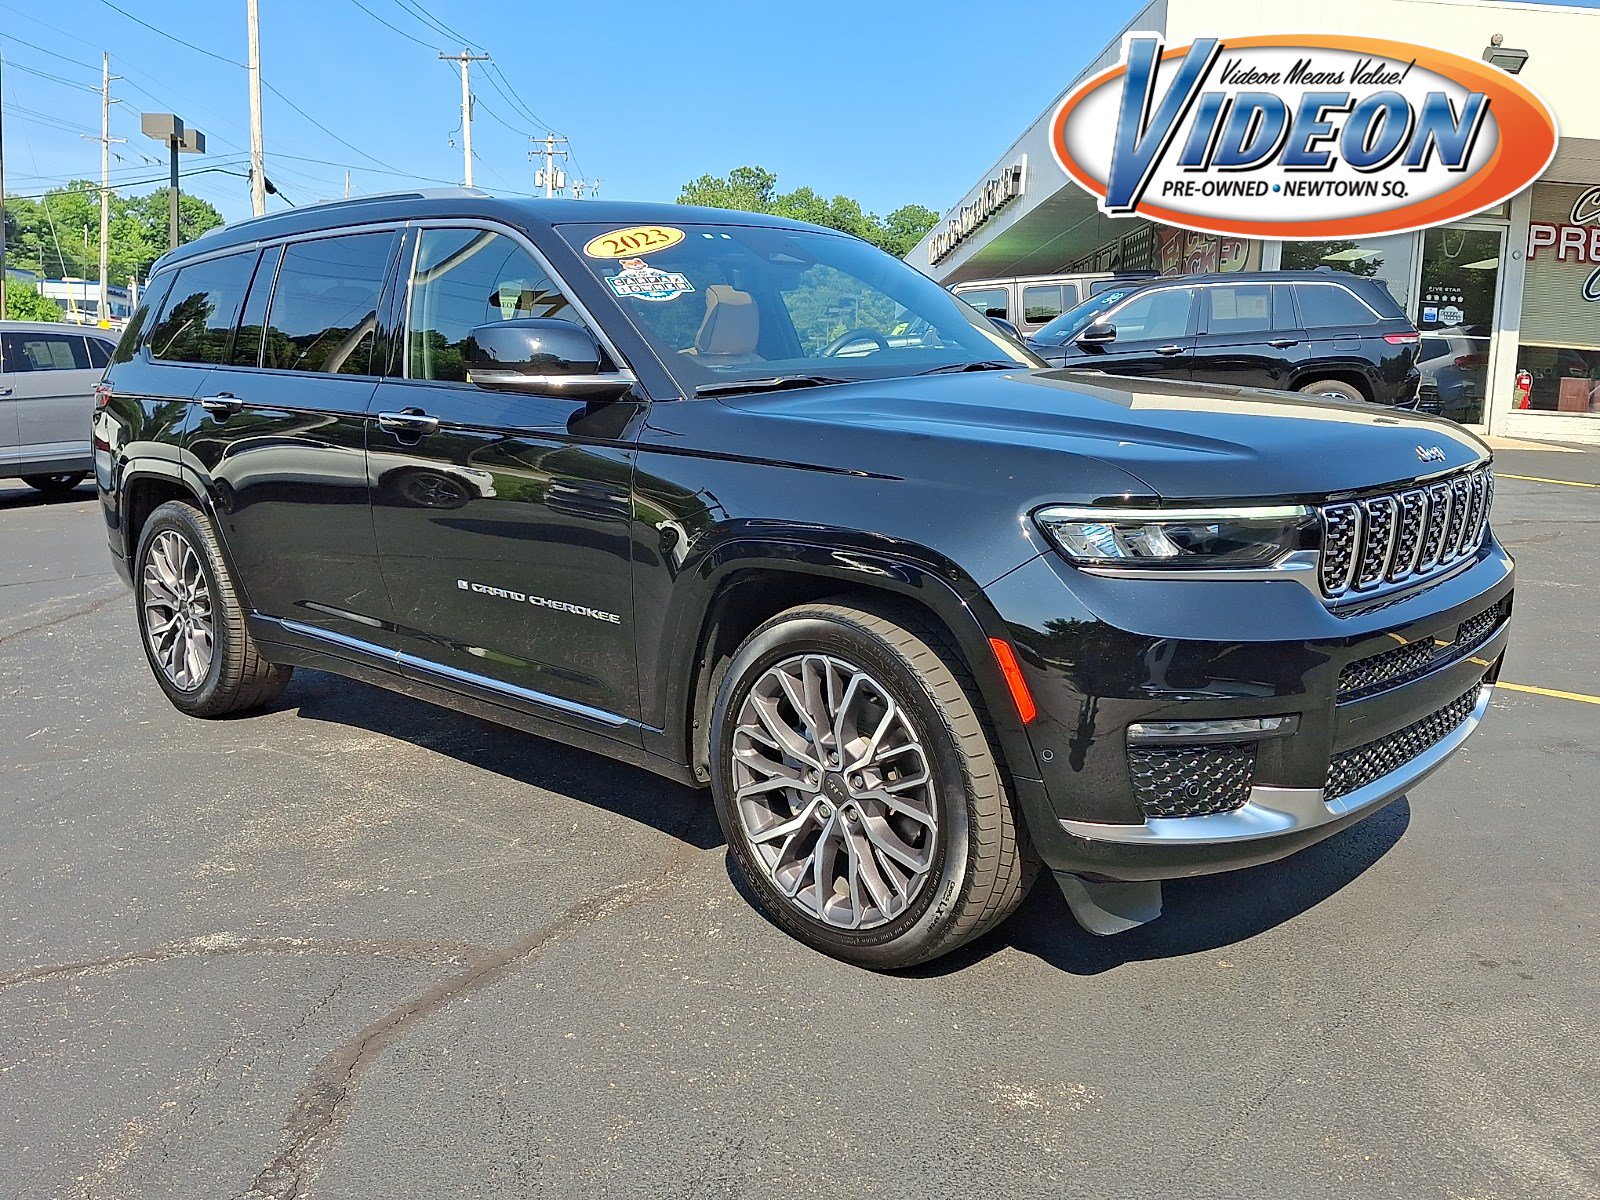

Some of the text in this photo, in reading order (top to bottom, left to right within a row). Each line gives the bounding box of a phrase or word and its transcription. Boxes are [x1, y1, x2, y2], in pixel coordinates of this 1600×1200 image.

[603, 229, 669, 254] 2023
[471, 582, 621, 624] GRAND CHEROKEE
